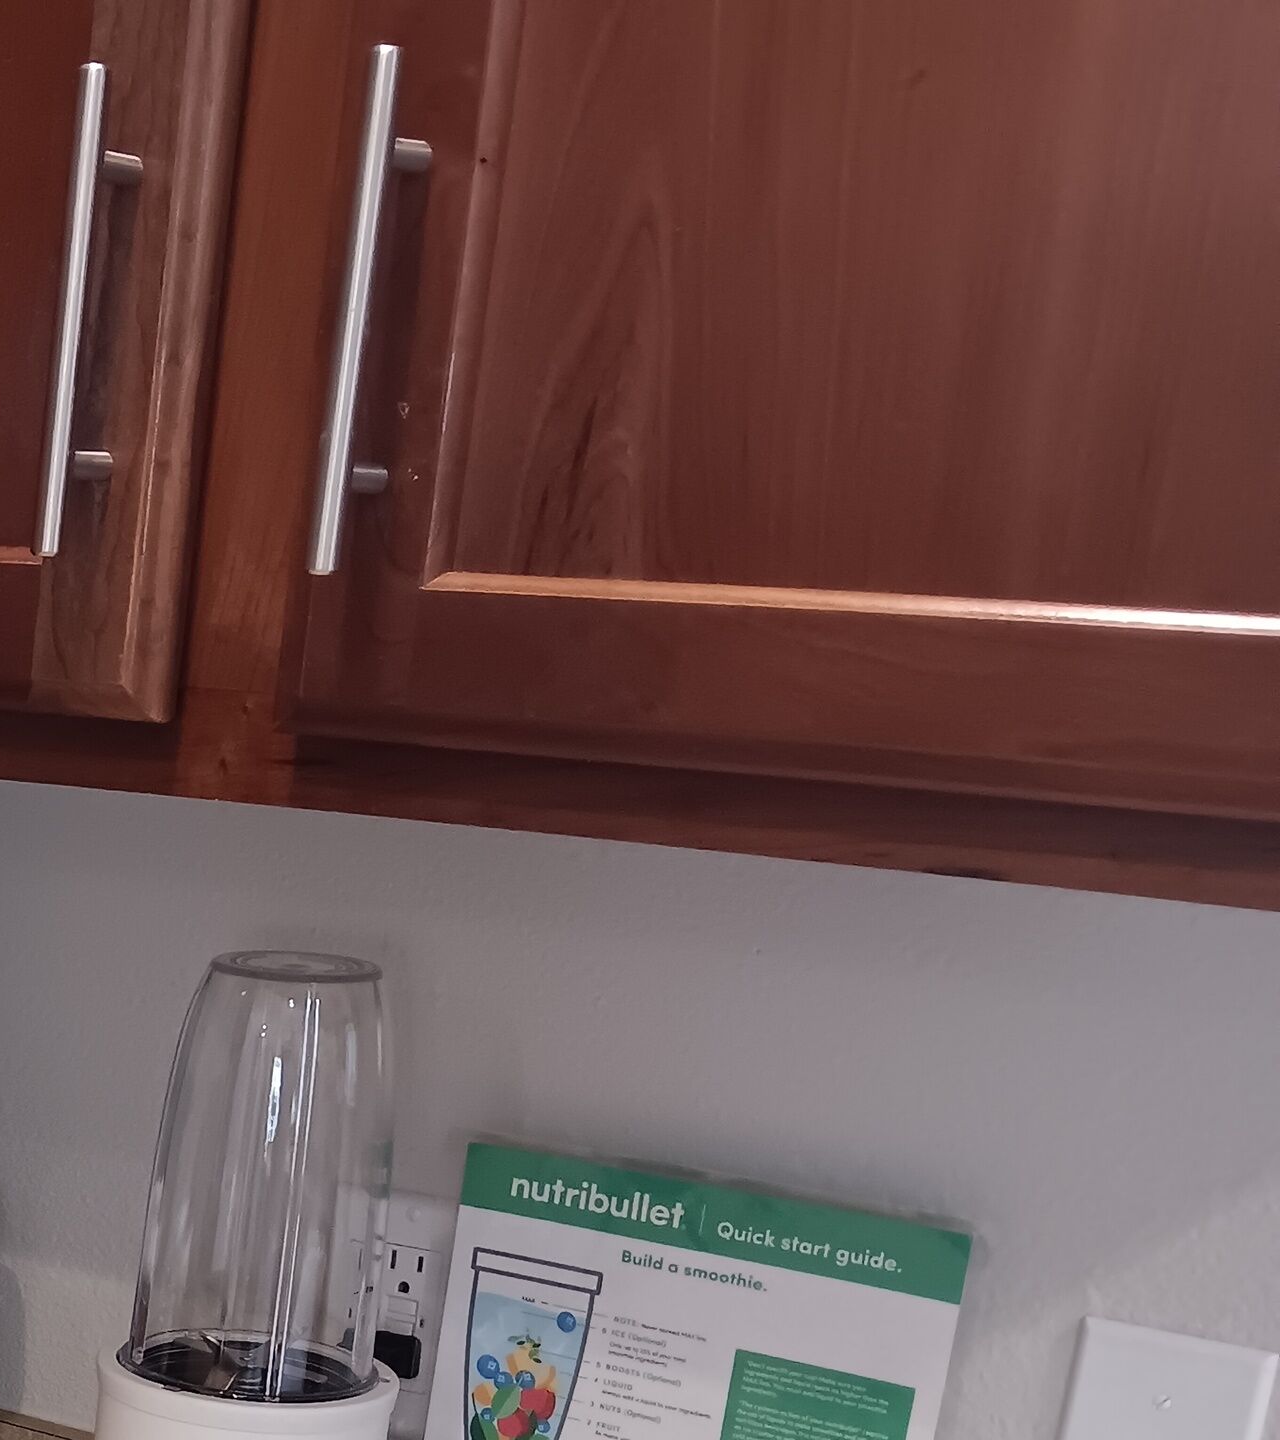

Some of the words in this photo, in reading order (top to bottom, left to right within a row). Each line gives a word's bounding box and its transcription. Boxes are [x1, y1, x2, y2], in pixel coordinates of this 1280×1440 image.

[509, 1175, 685, 1230] nutribullet
[716, 1221, 776, 1249] Quick
[779, 1235, 831, 1260] start
[835, 1239, 903, 1273] guide.
[621, 1249, 665, 1272] Build
[667, 1261, 680, 1275] a
[683, 1263, 769, 1292] smoothie.
